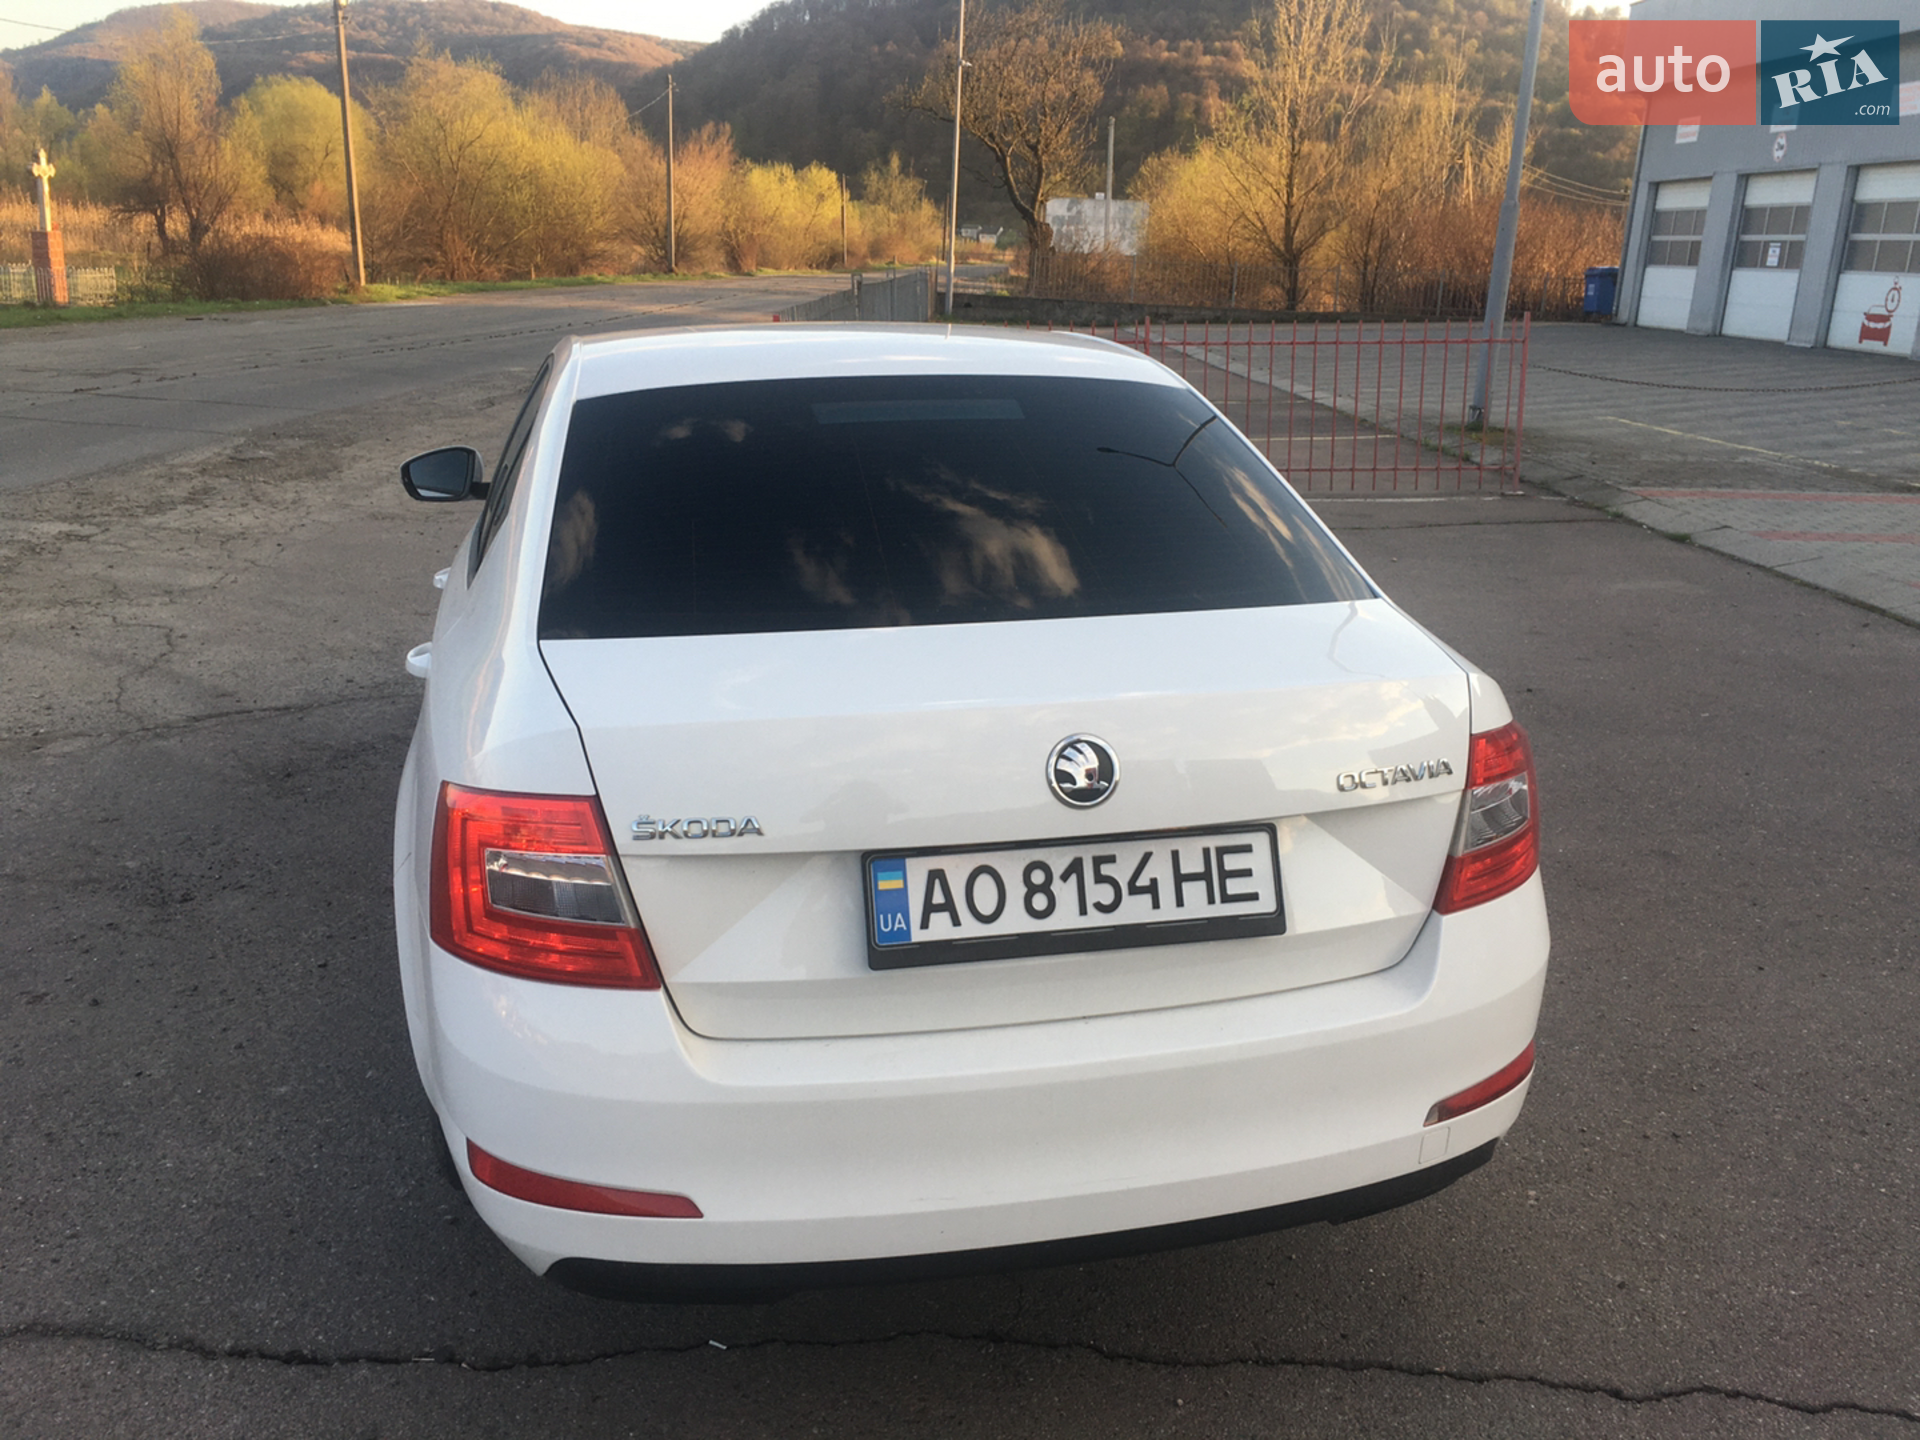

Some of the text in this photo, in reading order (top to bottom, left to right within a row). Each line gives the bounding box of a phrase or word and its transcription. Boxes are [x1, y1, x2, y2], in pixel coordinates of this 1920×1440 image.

[1336, 757, 1454, 793] OCTAVIA
[631, 814, 765, 841] ŠKODA
[919, 843, 1260, 931] AO 8154 HE
[879, 912, 907, 933] UA
